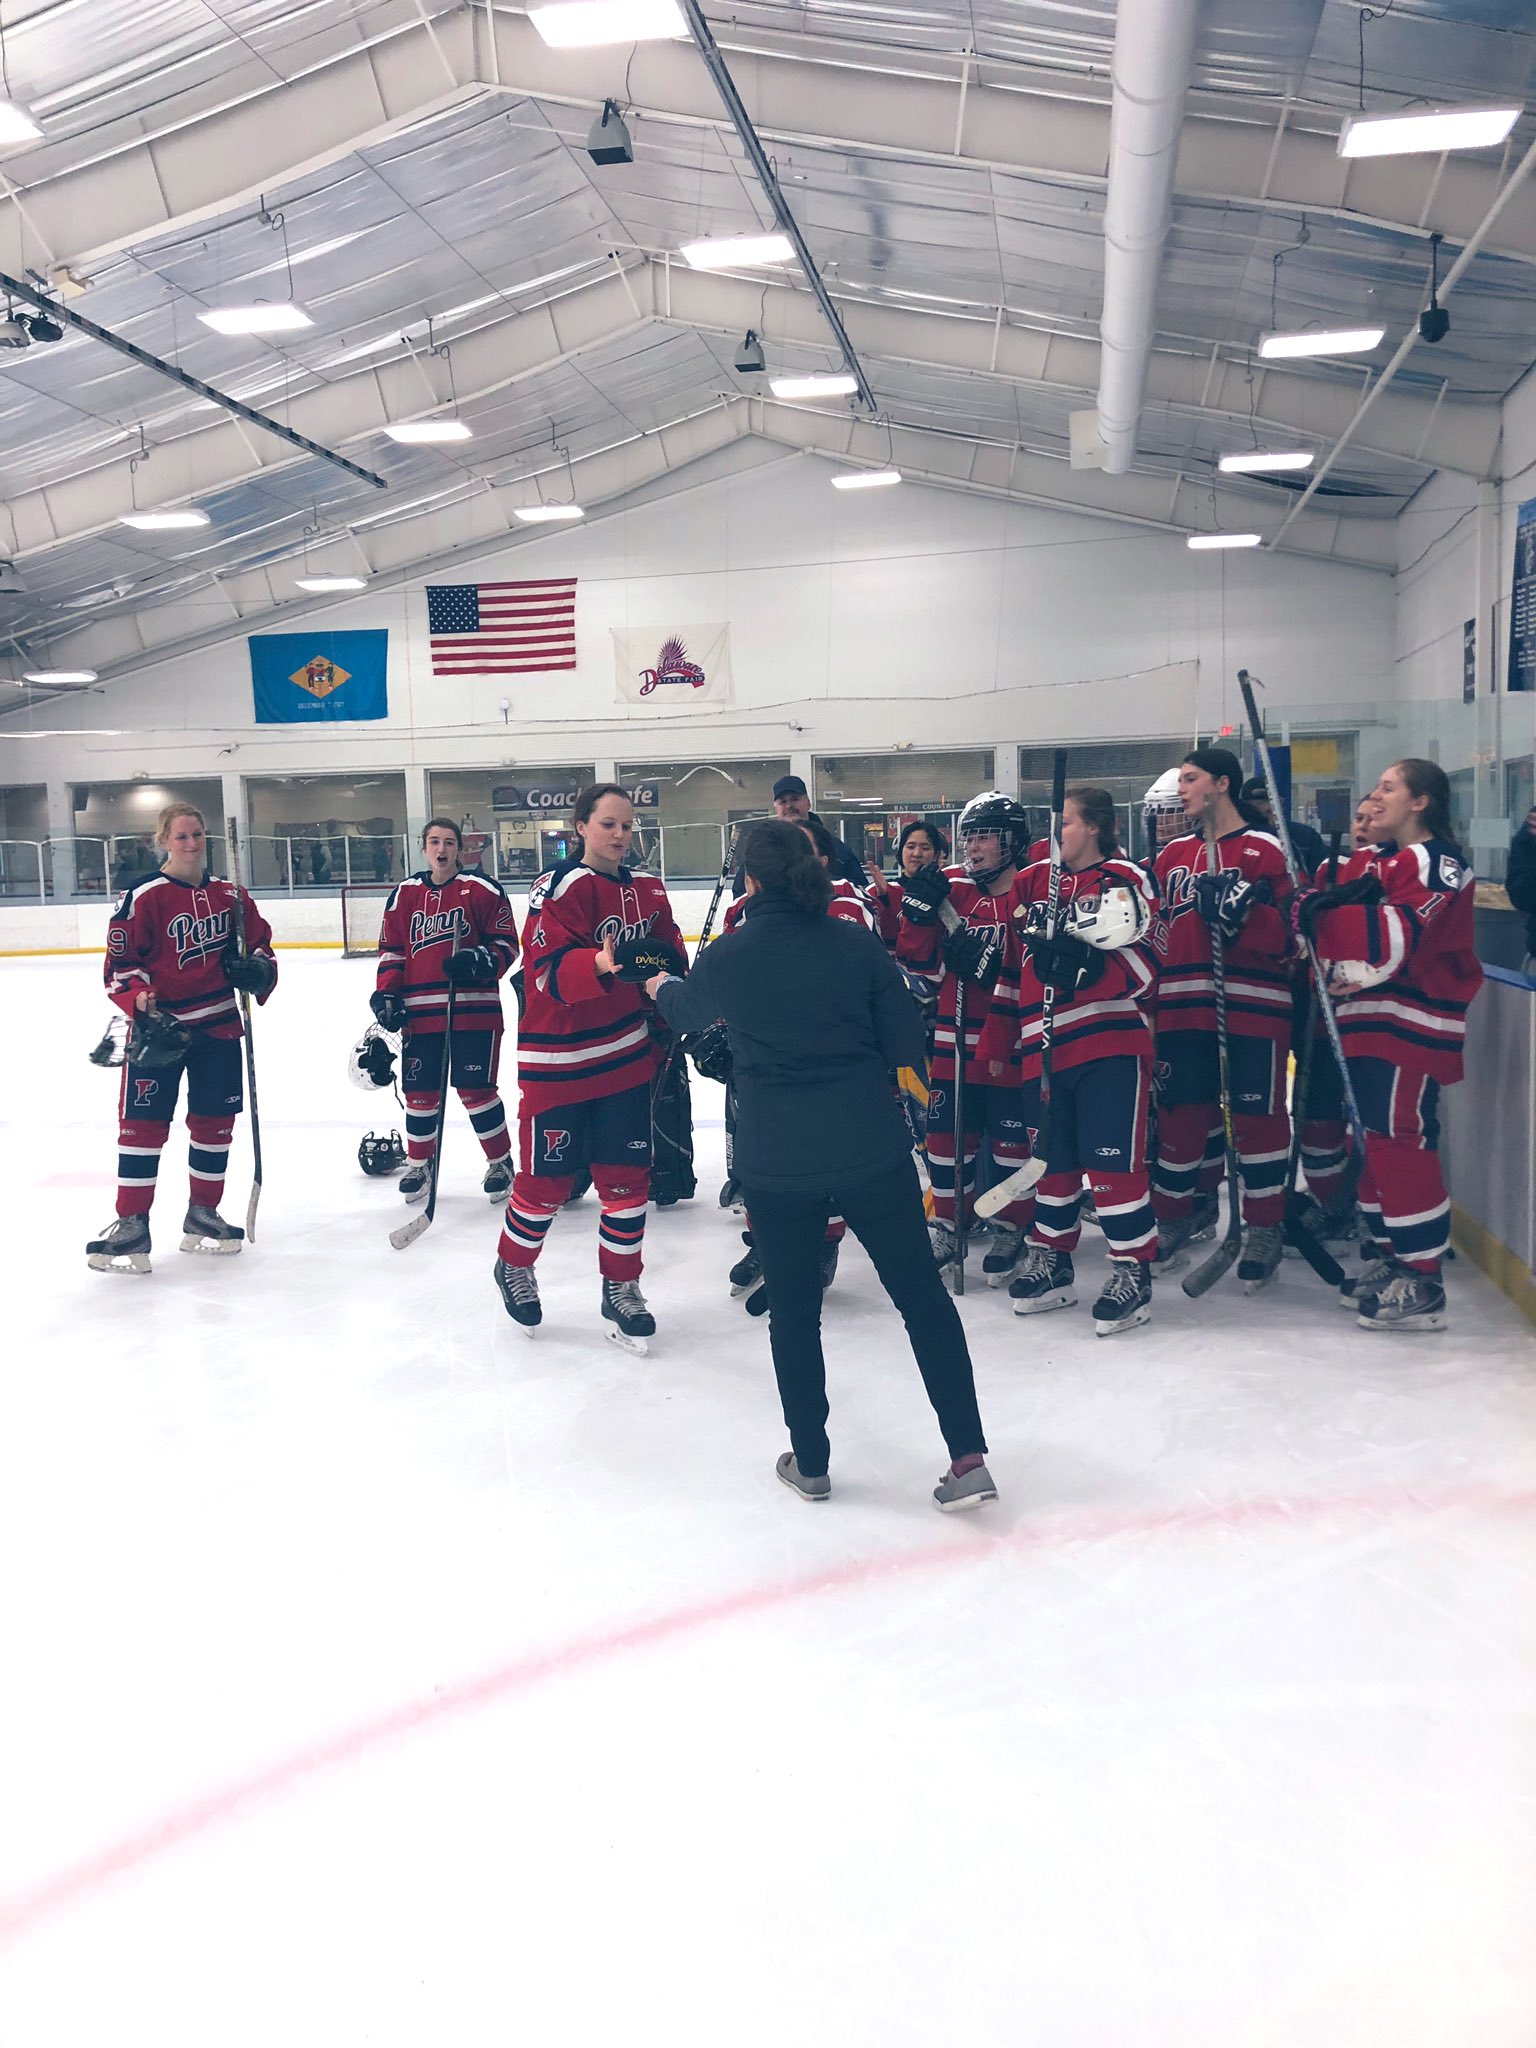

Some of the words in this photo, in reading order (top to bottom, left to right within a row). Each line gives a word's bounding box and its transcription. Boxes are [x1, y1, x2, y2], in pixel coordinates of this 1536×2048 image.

[638, 656, 704, 696] Delaware
[1047, 863, 1061, 921] BAUER
[410, 906, 467, 946] Penn
[496, 906, 512, 931] 2
[108, 927, 128, 957] 9
[955, 979, 965, 1028] BAUER
[1041, 982, 1054, 1050] VAPO
[406, 1057, 423, 1081] P
[134, 1078, 159, 1107] P
[929, 1089, 946, 1119] P
[543, 1129, 571, 1161] P
[726, 1132, 734, 1170] VAUGHN
